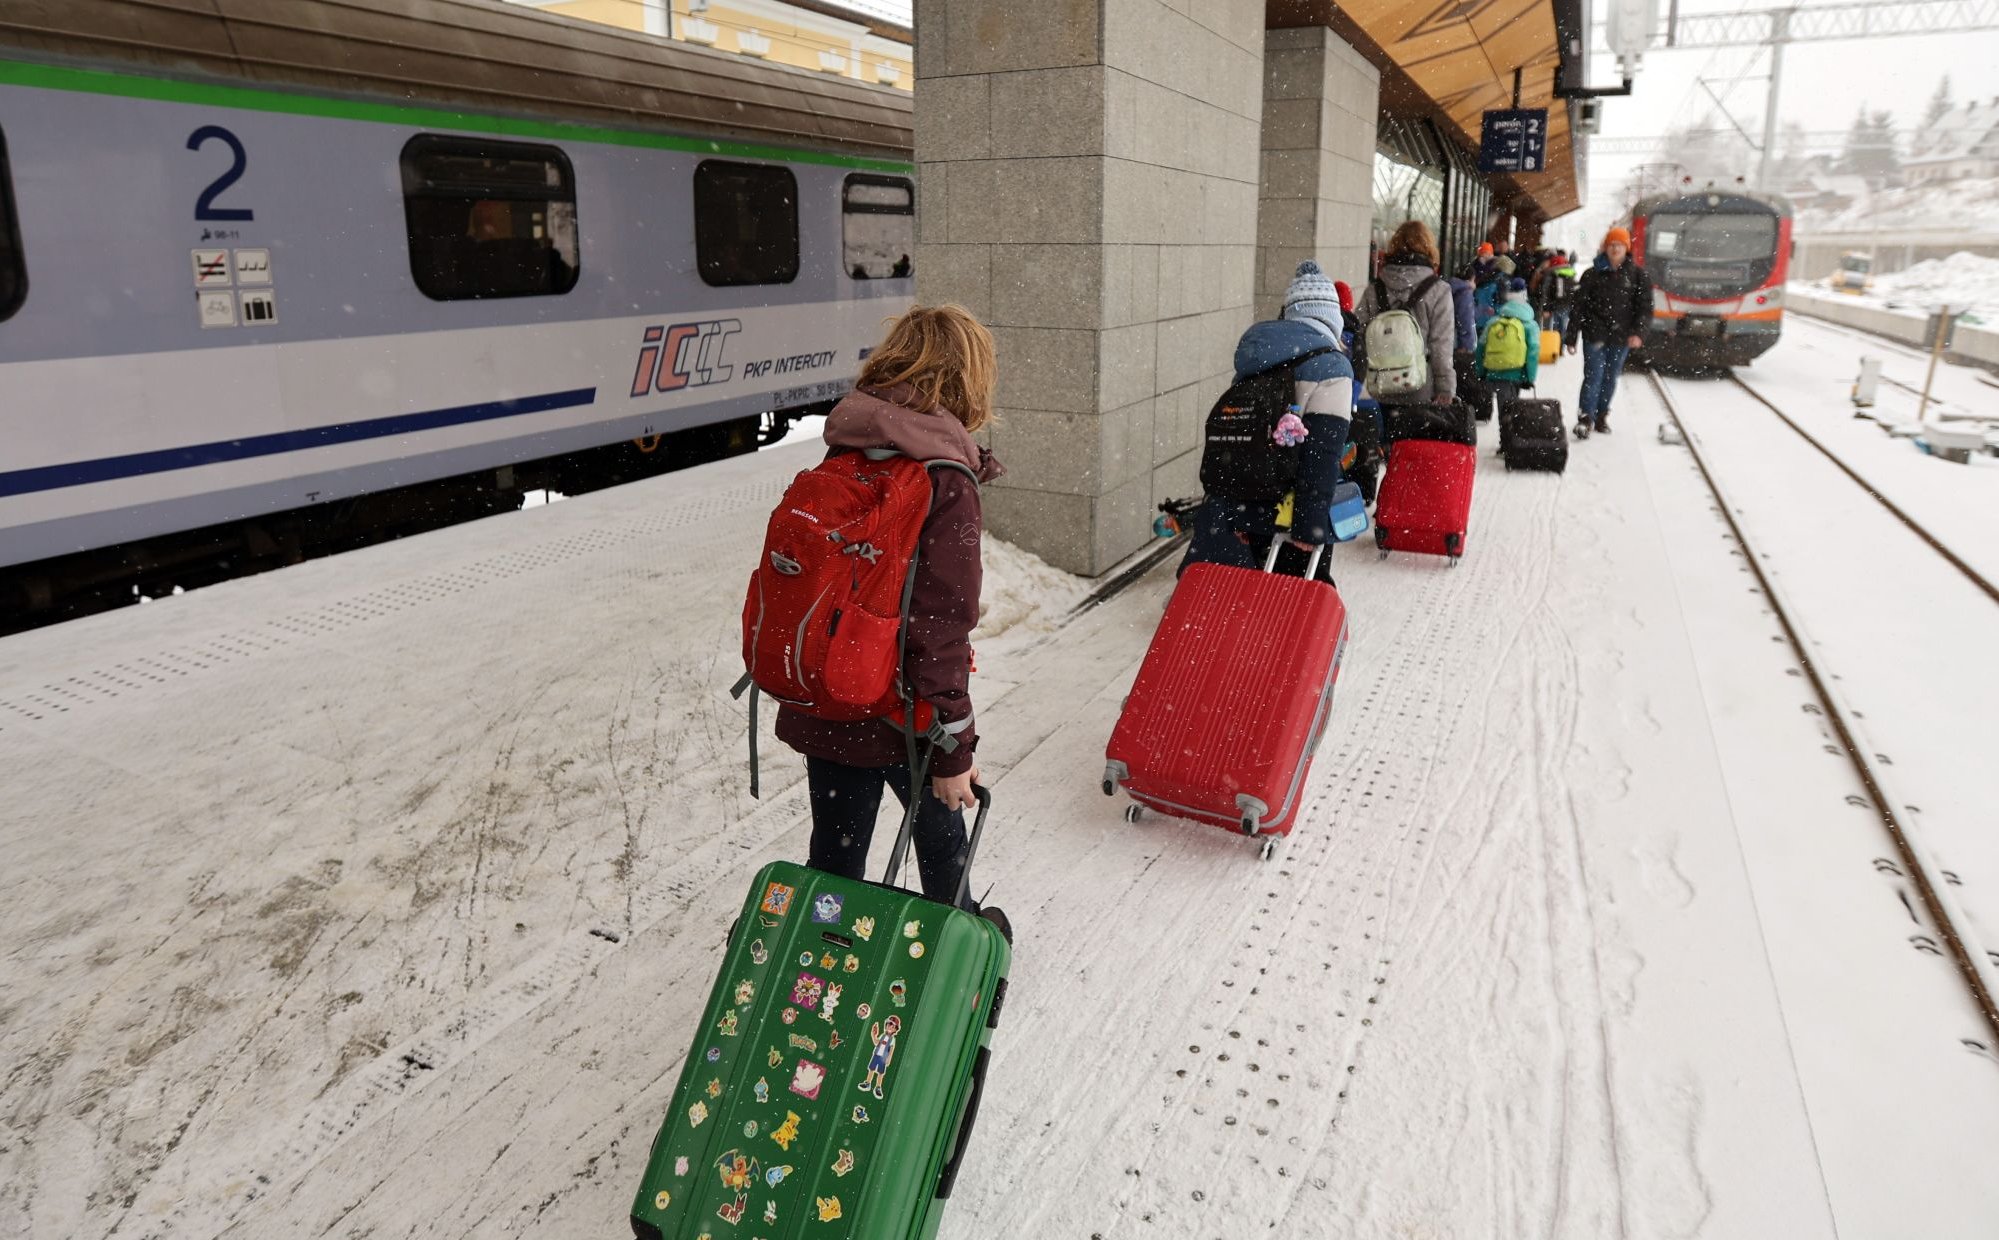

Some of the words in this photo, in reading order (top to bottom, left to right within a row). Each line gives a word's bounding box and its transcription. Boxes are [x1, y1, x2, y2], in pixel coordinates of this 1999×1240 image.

[1528, 119, 1539, 134] 2
[186, 125, 254, 221] 2
[743, 360, 772, 380] PKP
[774, 350, 837, 375] INTERCITY
[790, 508, 819, 524] BERGSON
